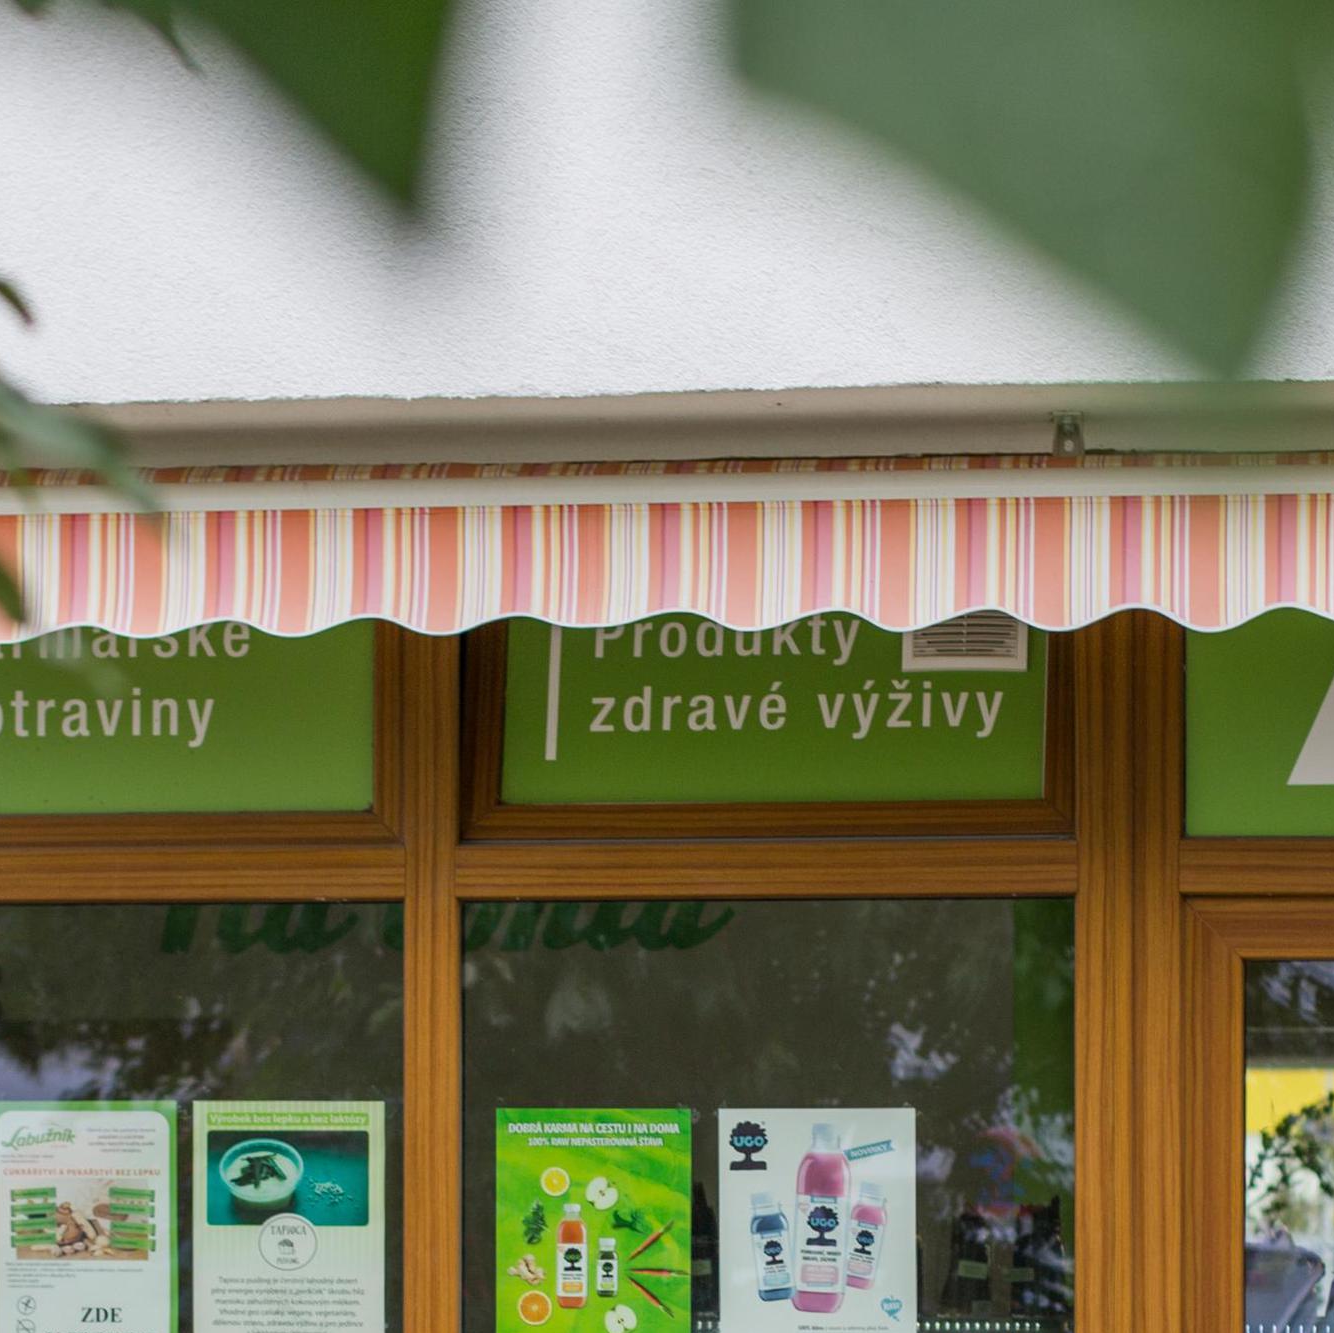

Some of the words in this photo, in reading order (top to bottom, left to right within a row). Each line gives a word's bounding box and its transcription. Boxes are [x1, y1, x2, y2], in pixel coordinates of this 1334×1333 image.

[594, 613, 860, 666] Produkty
[589, 681, 788, 732] zdravé
[818, 680, 1004, 740] výživy
[597, 1122, 626, 1134] CESTU
[732, 1136, 765, 1148] UGO
[811, 1217, 836, 1227] UGO
[81, 1307, 123, 1323] ZDE
